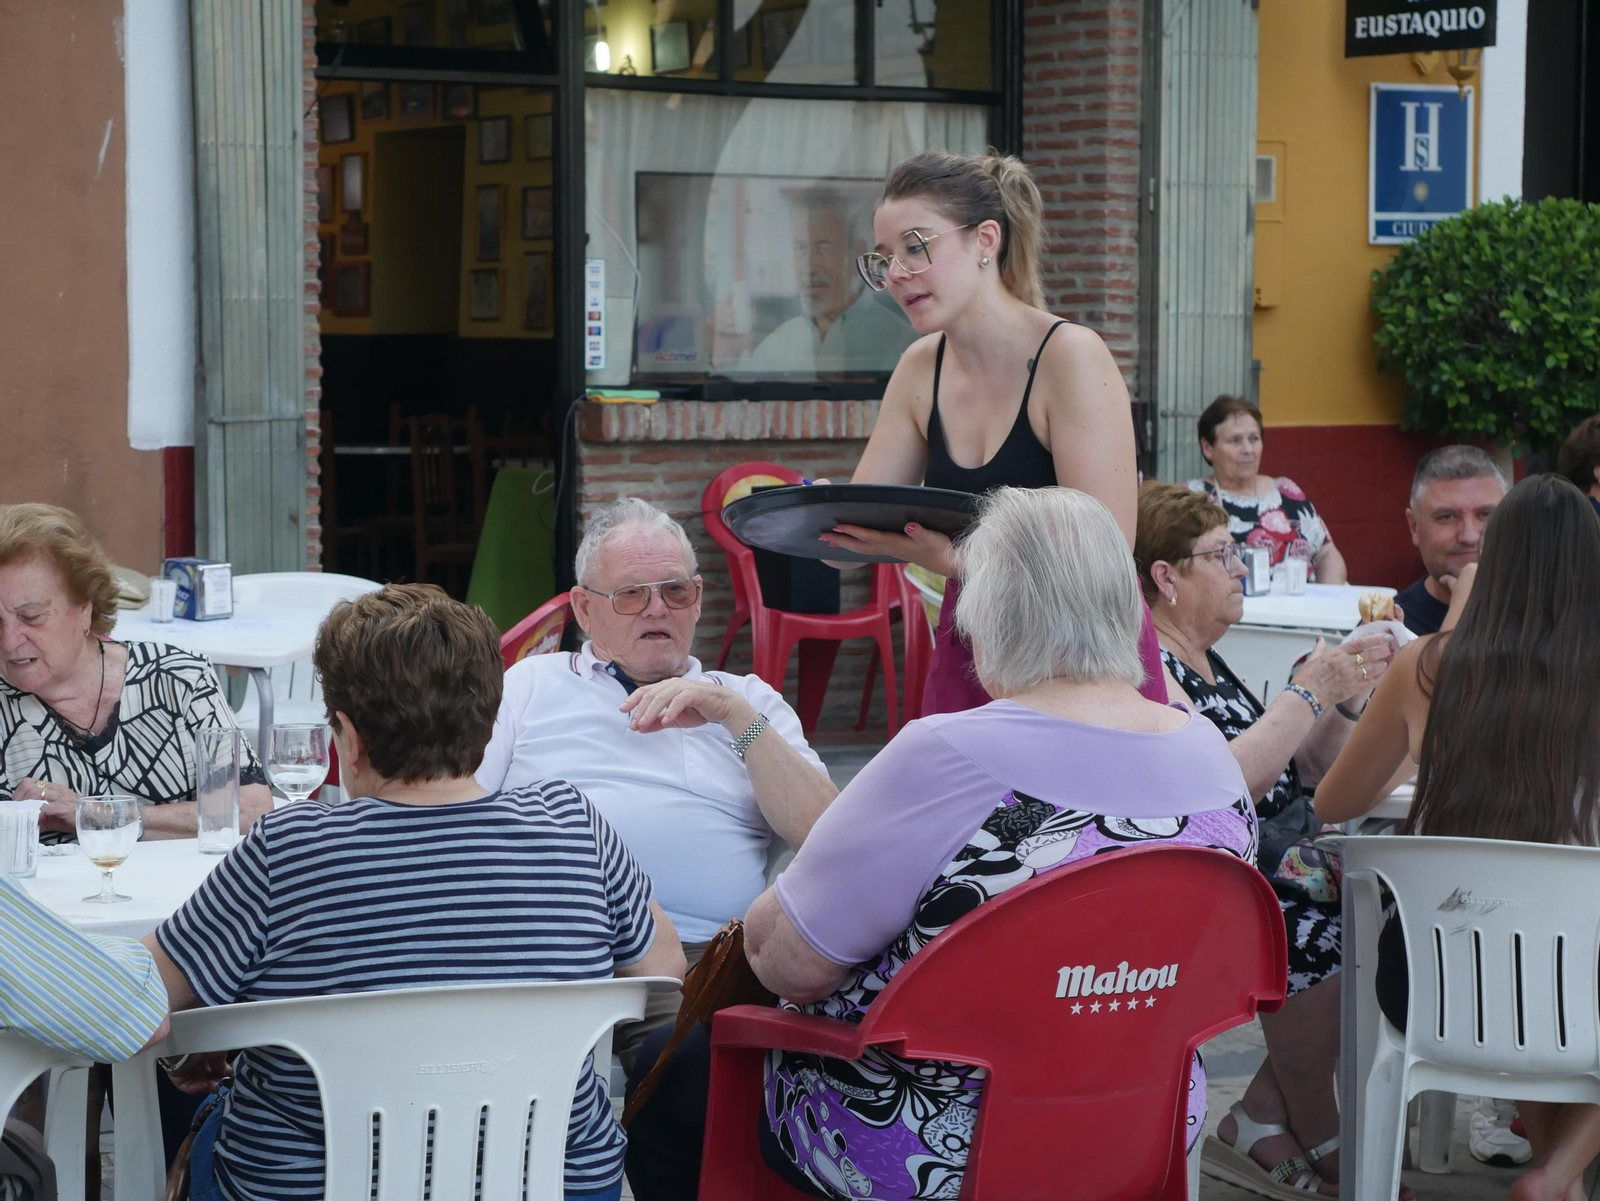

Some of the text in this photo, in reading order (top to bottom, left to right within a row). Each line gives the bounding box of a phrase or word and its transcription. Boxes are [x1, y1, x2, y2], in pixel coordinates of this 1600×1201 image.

[1354, 6, 1486, 39] EUSTAQUIO
[1392, 220, 1435, 236] CIUD
[654, 349, 698, 362] Actimel
[1055, 960, 1179, 998] Mahou
[416, 1060, 488, 1076] ALLIBERT
